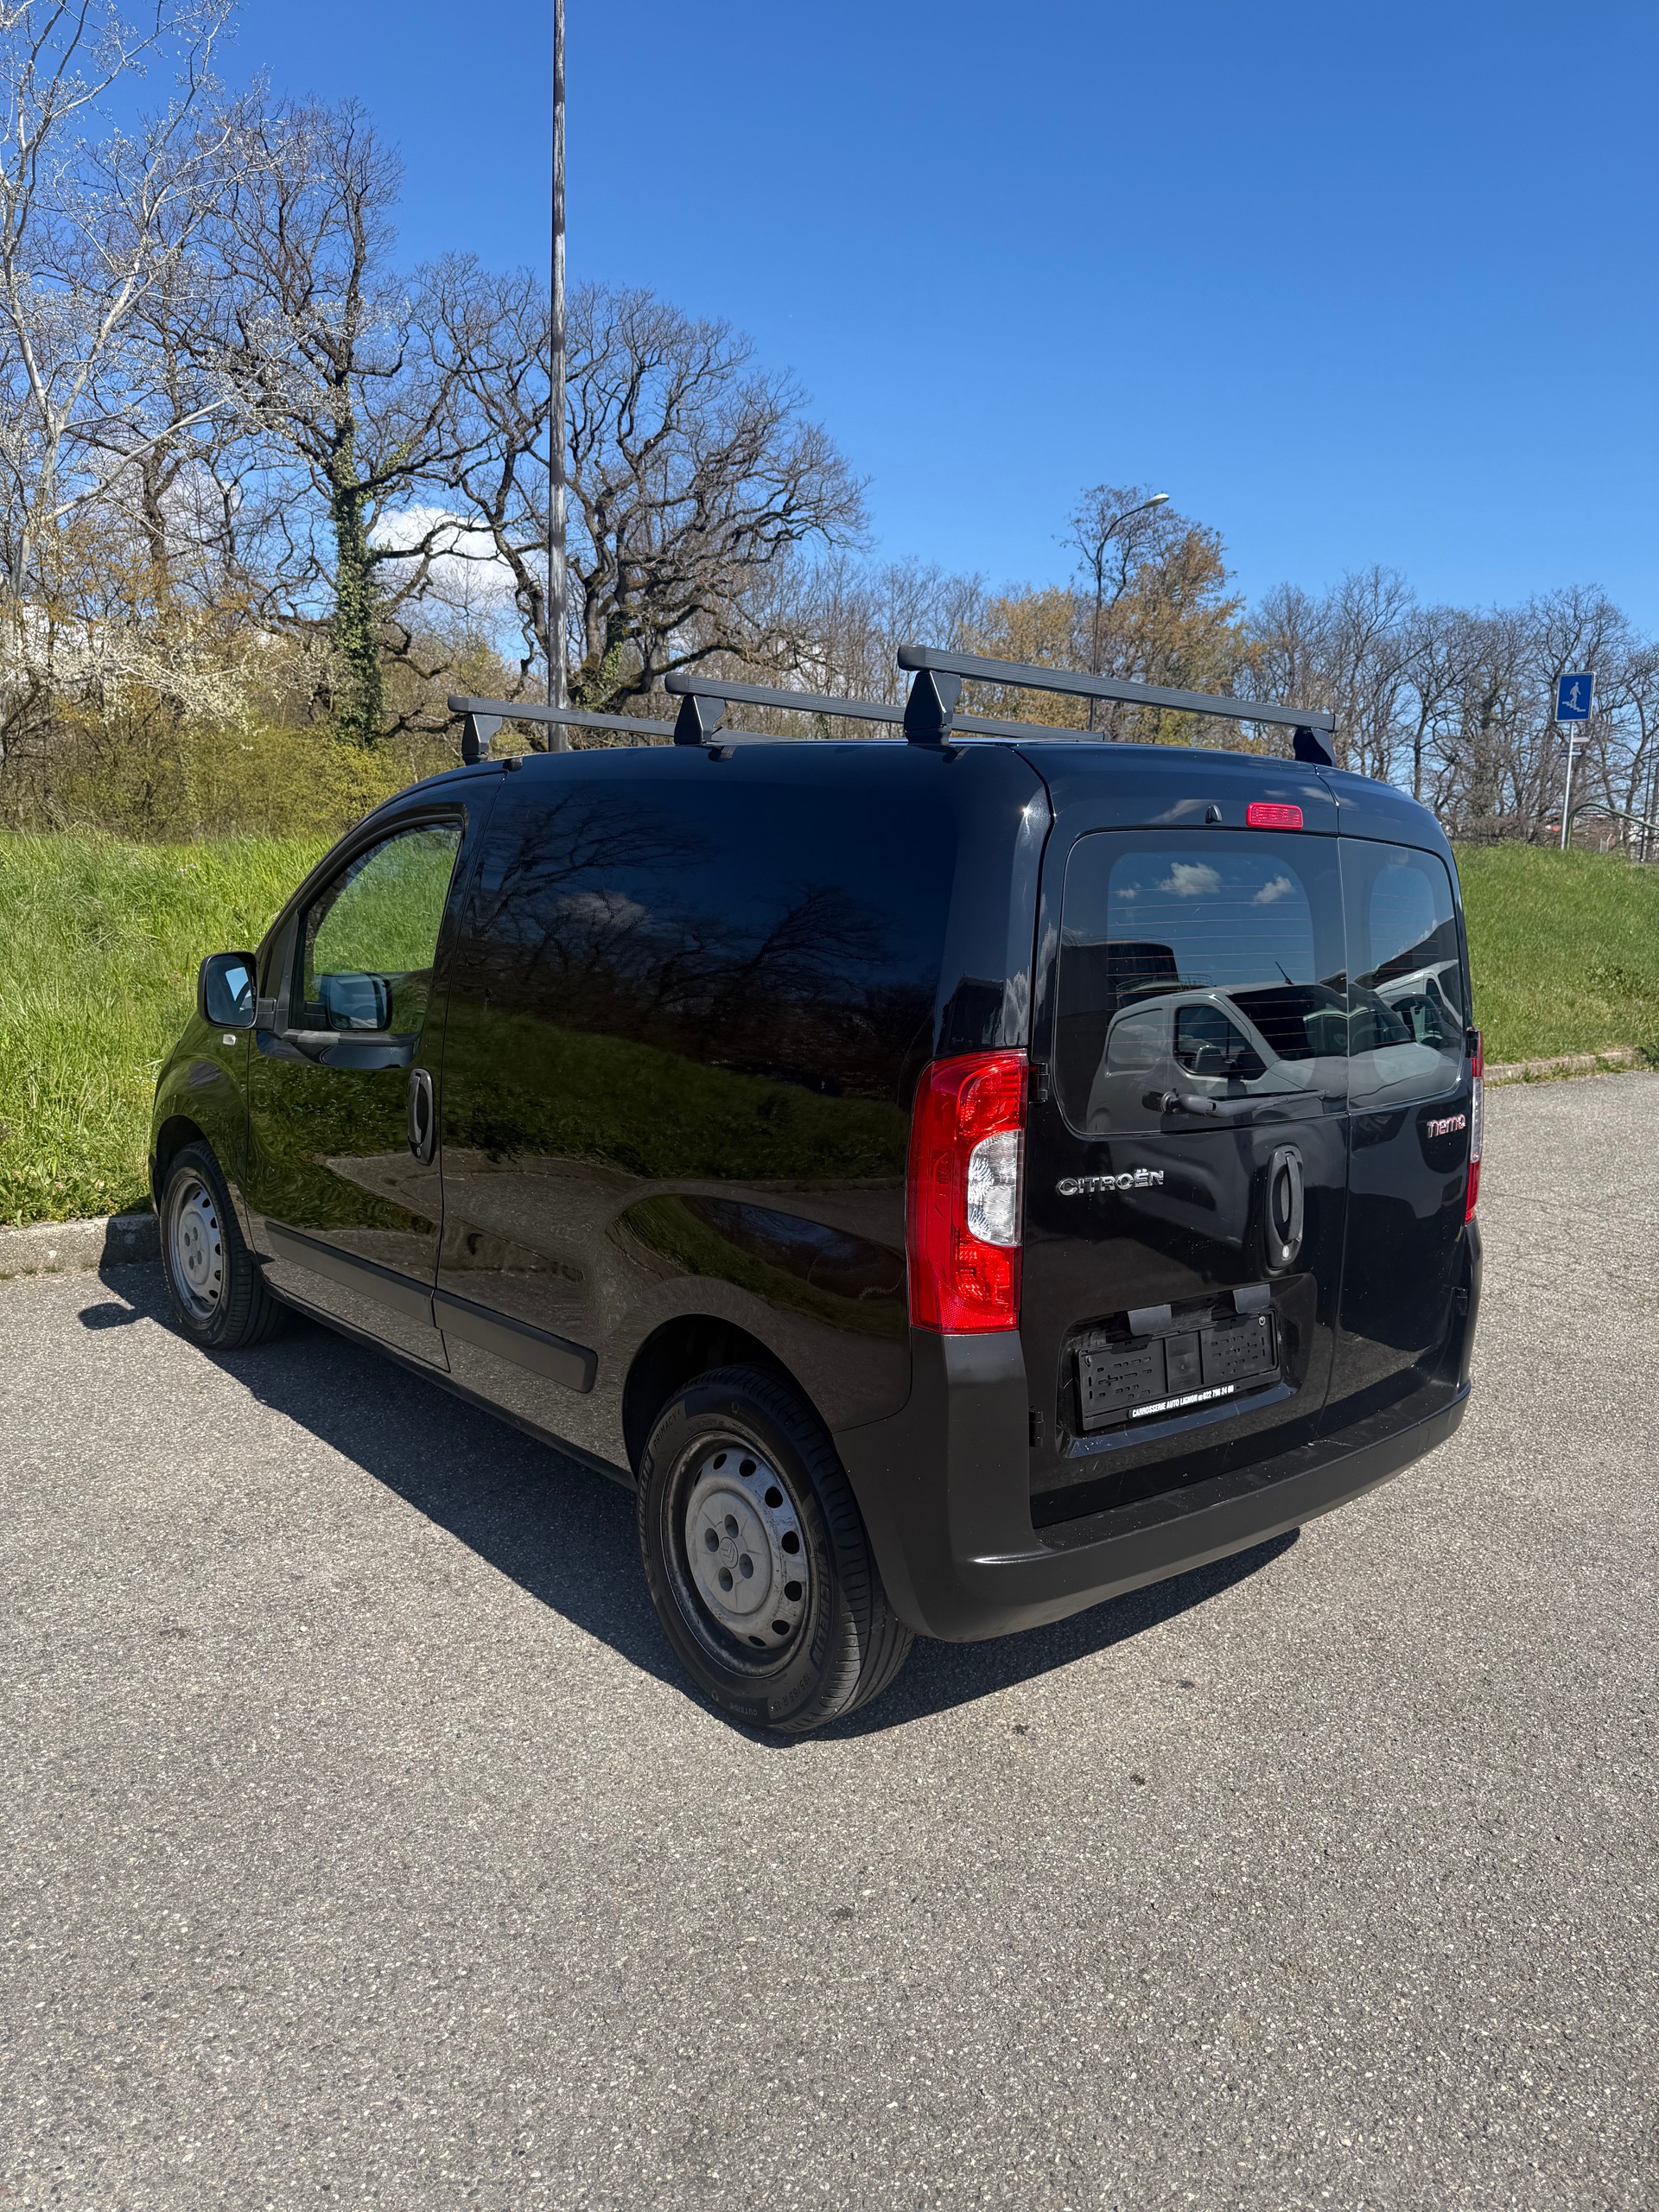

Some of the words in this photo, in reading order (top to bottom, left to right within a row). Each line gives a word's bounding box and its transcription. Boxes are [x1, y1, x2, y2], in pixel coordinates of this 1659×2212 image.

[1427, 1114, 1466, 1138] nemo
[1056, 1167, 1164, 1196] CITROËN
[1132, 1402, 1166, 1418] CARROSSERIE
[1166, 1398, 1179, 1409] AUTO
[1203, 1390, 1212, 1400] 022
[1221, 1386, 1228, 1395] 24
[652, 1410, 677, 1449] PRIMACY
[639, 1452, 653, 1555] MICHELIN
[814, 1553, 830, 1668] MICHELIN
[789, 1672, 810, 1702] 185/65
